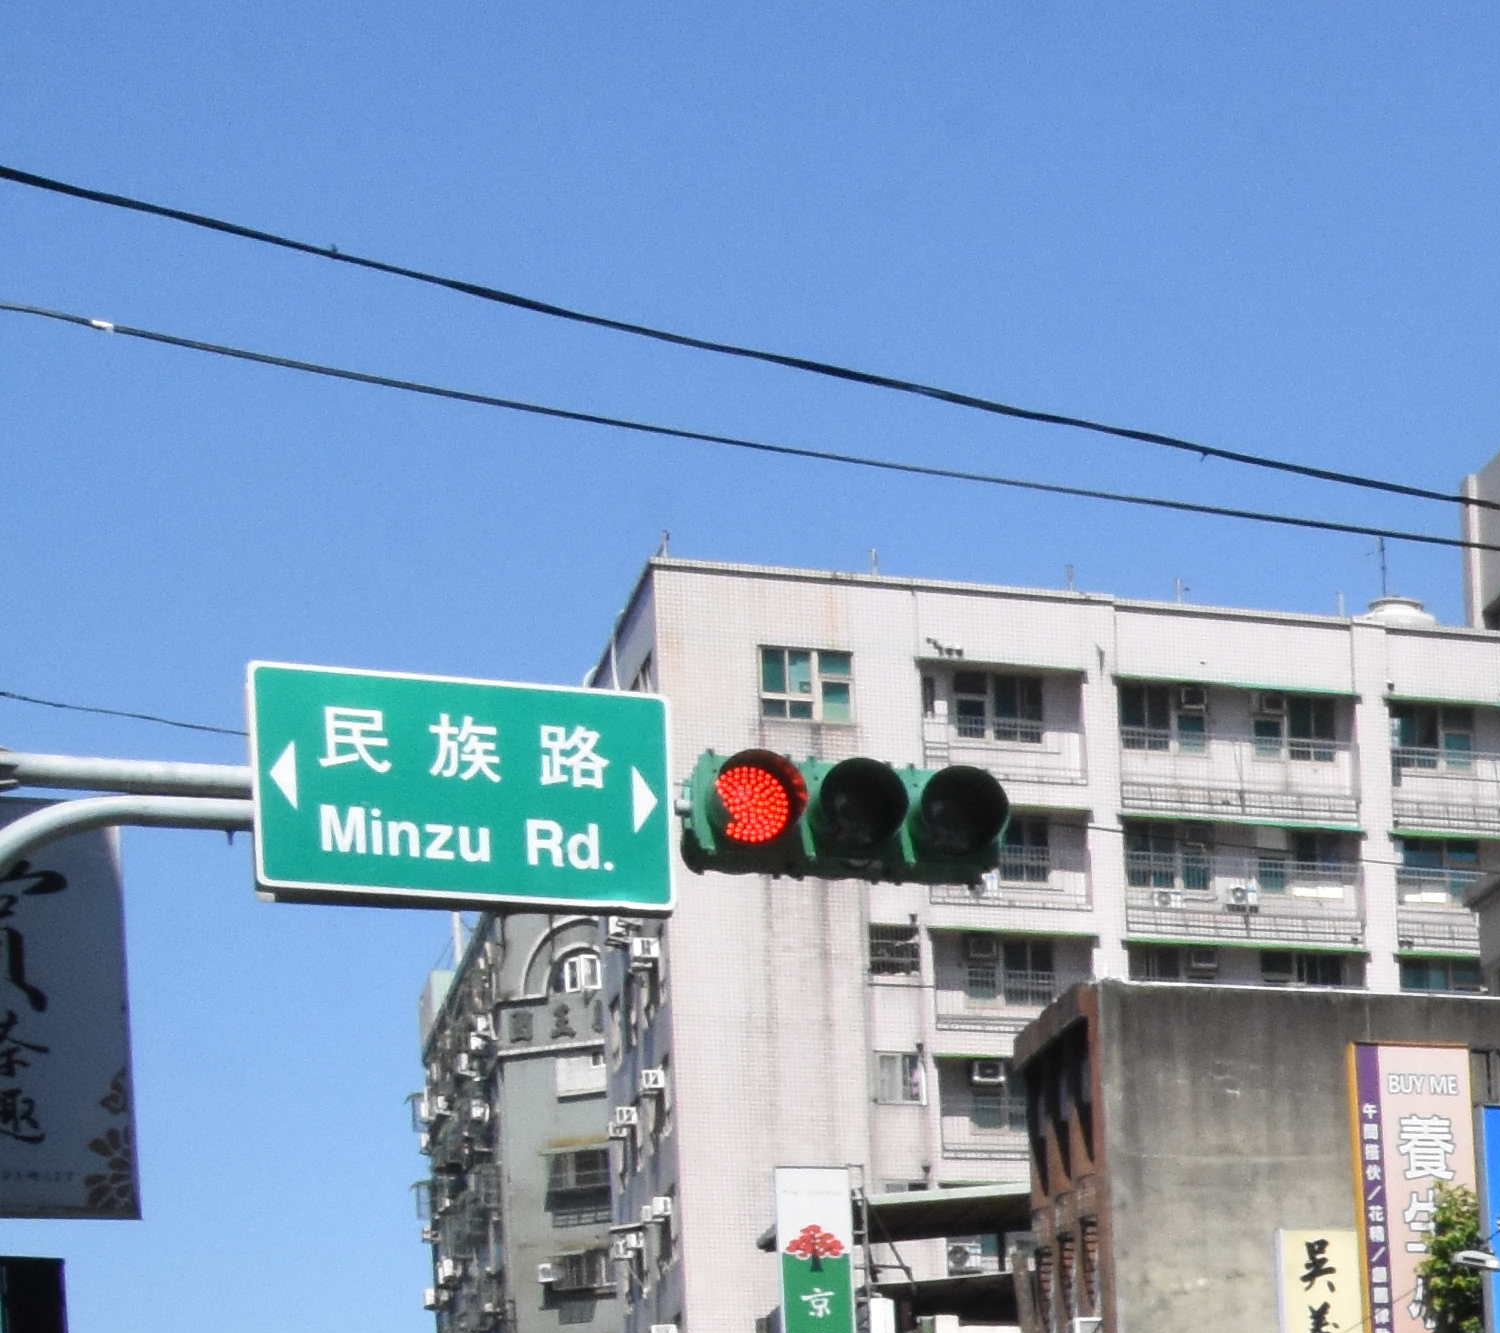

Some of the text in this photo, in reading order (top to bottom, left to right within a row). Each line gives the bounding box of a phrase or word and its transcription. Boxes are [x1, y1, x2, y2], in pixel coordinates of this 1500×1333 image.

[316, 706, 611, 790] 民族路
[319, 804, 615, 873] Minzu Rd.
[1388, 1074, 1459, 1095] BUY ME
